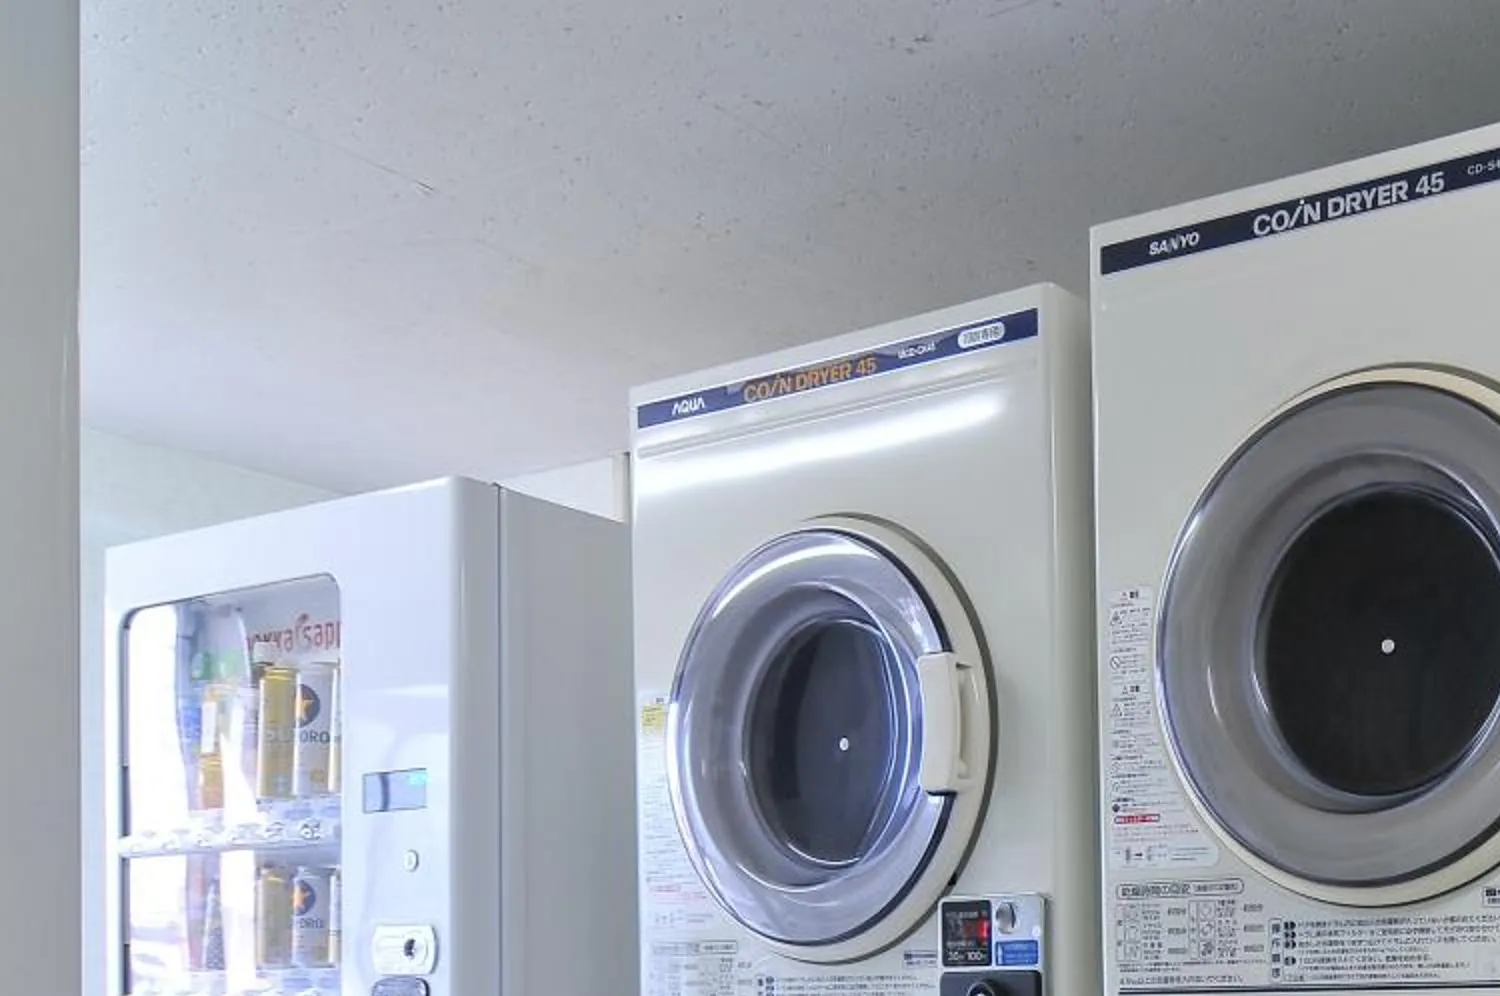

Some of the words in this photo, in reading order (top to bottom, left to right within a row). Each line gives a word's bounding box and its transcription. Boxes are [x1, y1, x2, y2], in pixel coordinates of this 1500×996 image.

[1149, 231, 1200, 256] SANYO
[1252, 199, 1321, 236] COIN
[1327, 180, 1409, 218] DRYER
[1415, 171, 1445, 196] 45
[672, 397, 706, 416] AQUA
[744, 373, 797, 403] COIN
[796, 364, 853, 391] DRYER
[856, 357, 878, 375] 45
